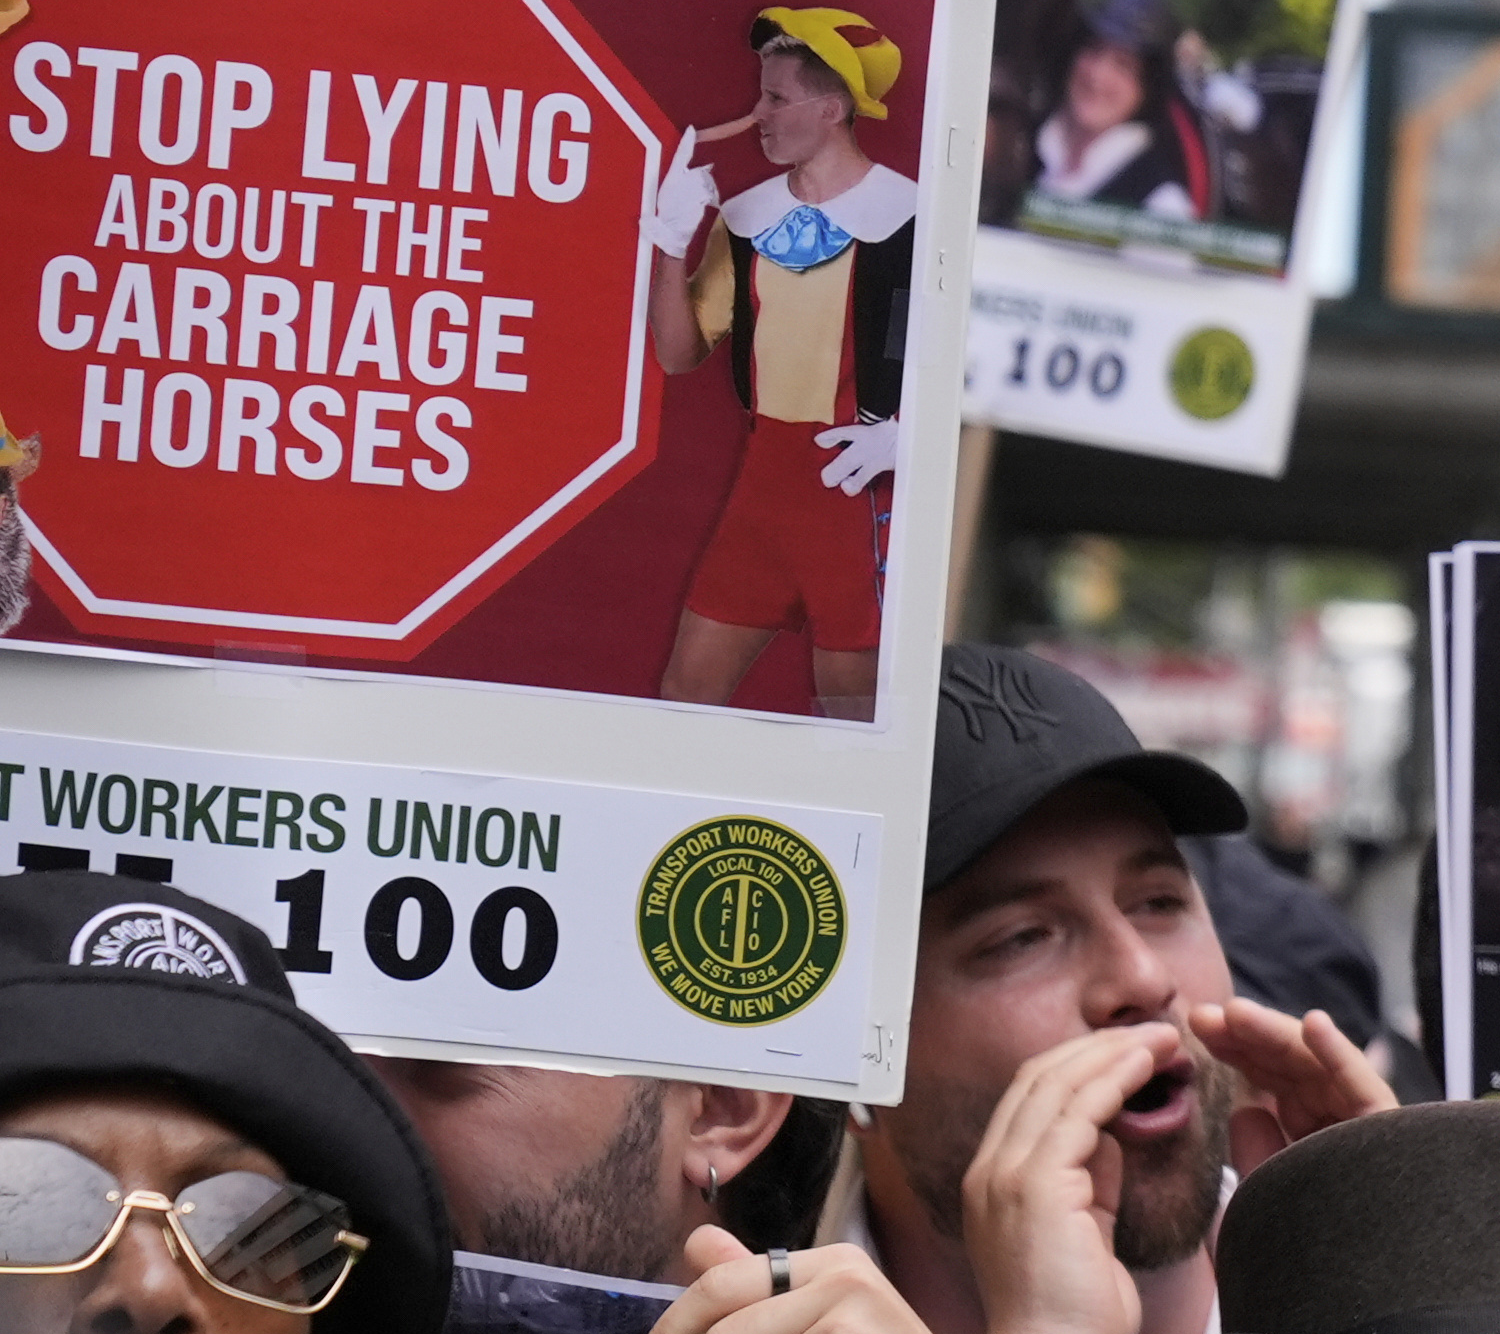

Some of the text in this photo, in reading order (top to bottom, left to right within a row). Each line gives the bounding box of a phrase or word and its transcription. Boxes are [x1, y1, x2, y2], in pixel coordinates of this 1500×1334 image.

[9, 41, 592, 205] STOP LYING
[94, 173, 490, 283] ABOUT THE
[37, 255, 534, 392] CARRIAGE
[78, 365, 473, 492] HORSES
[40, 767, 561, 872] WORKERS UNION
[273, 869, 559, 992] 100
